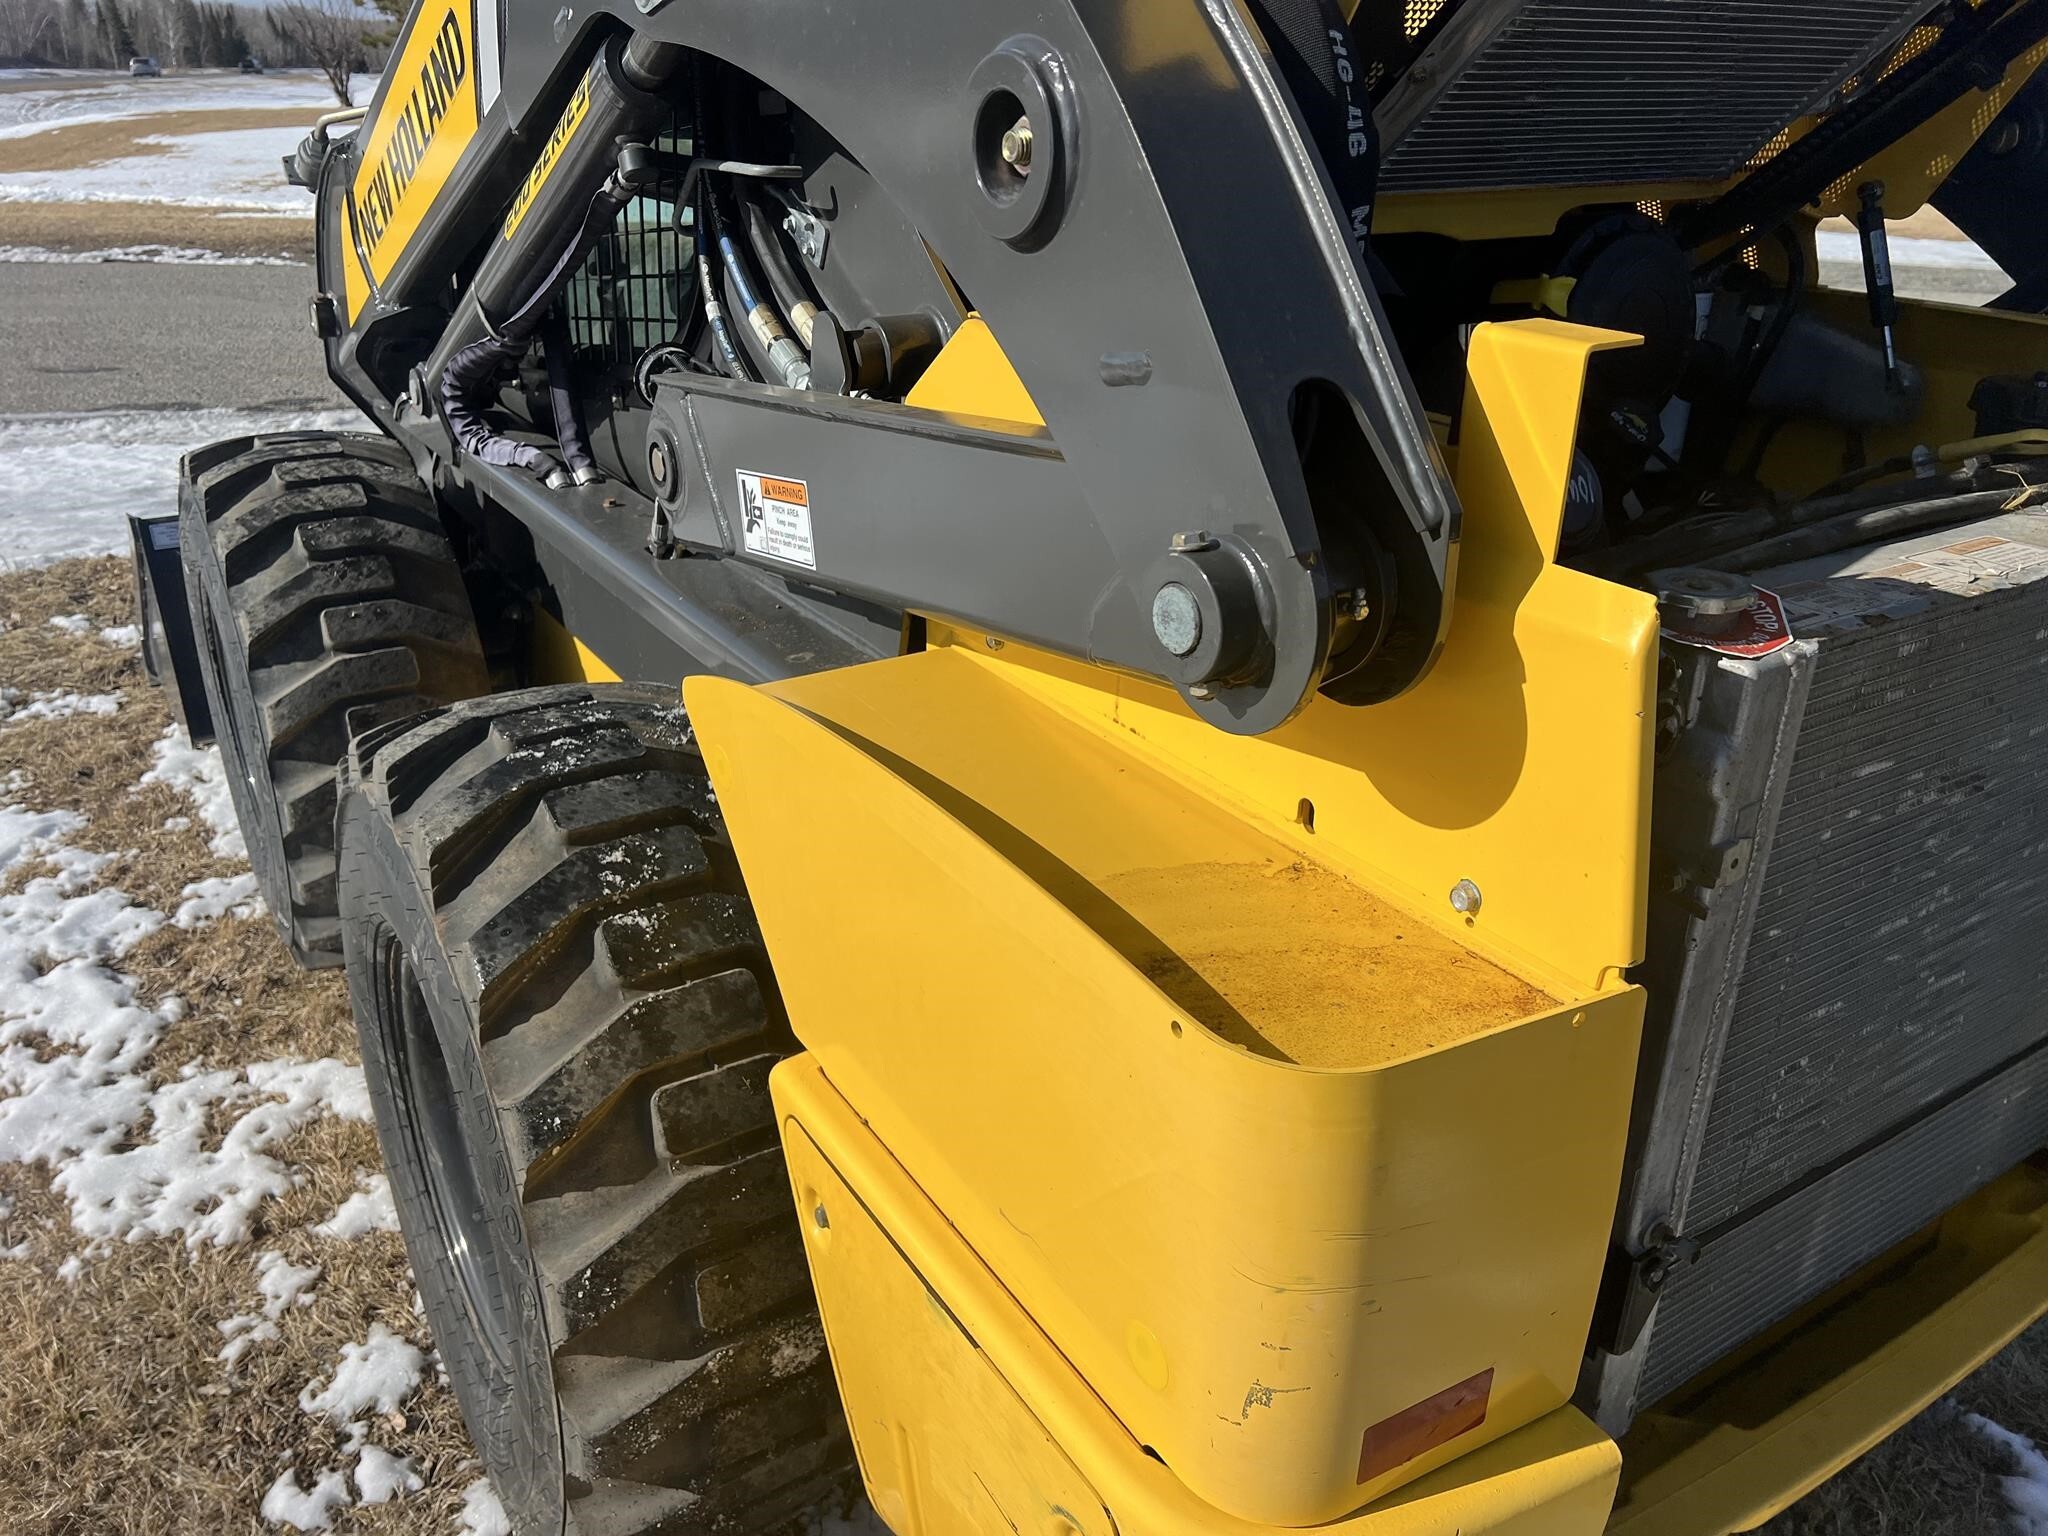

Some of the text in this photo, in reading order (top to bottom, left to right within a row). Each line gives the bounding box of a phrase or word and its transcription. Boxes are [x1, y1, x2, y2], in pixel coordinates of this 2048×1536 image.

[1328, 29, 1368, 157] HG-46
[358, 7, 466, 257] NEW HOLLAND
[533, 75, 587, 186] SERIES
[771, 484, 803, 500] WARNING
[771, 504, 799, 518] PINCH AREA
[776, 517, 786, 526] Keep
[1747, 601, 1779, 632] STOP!
